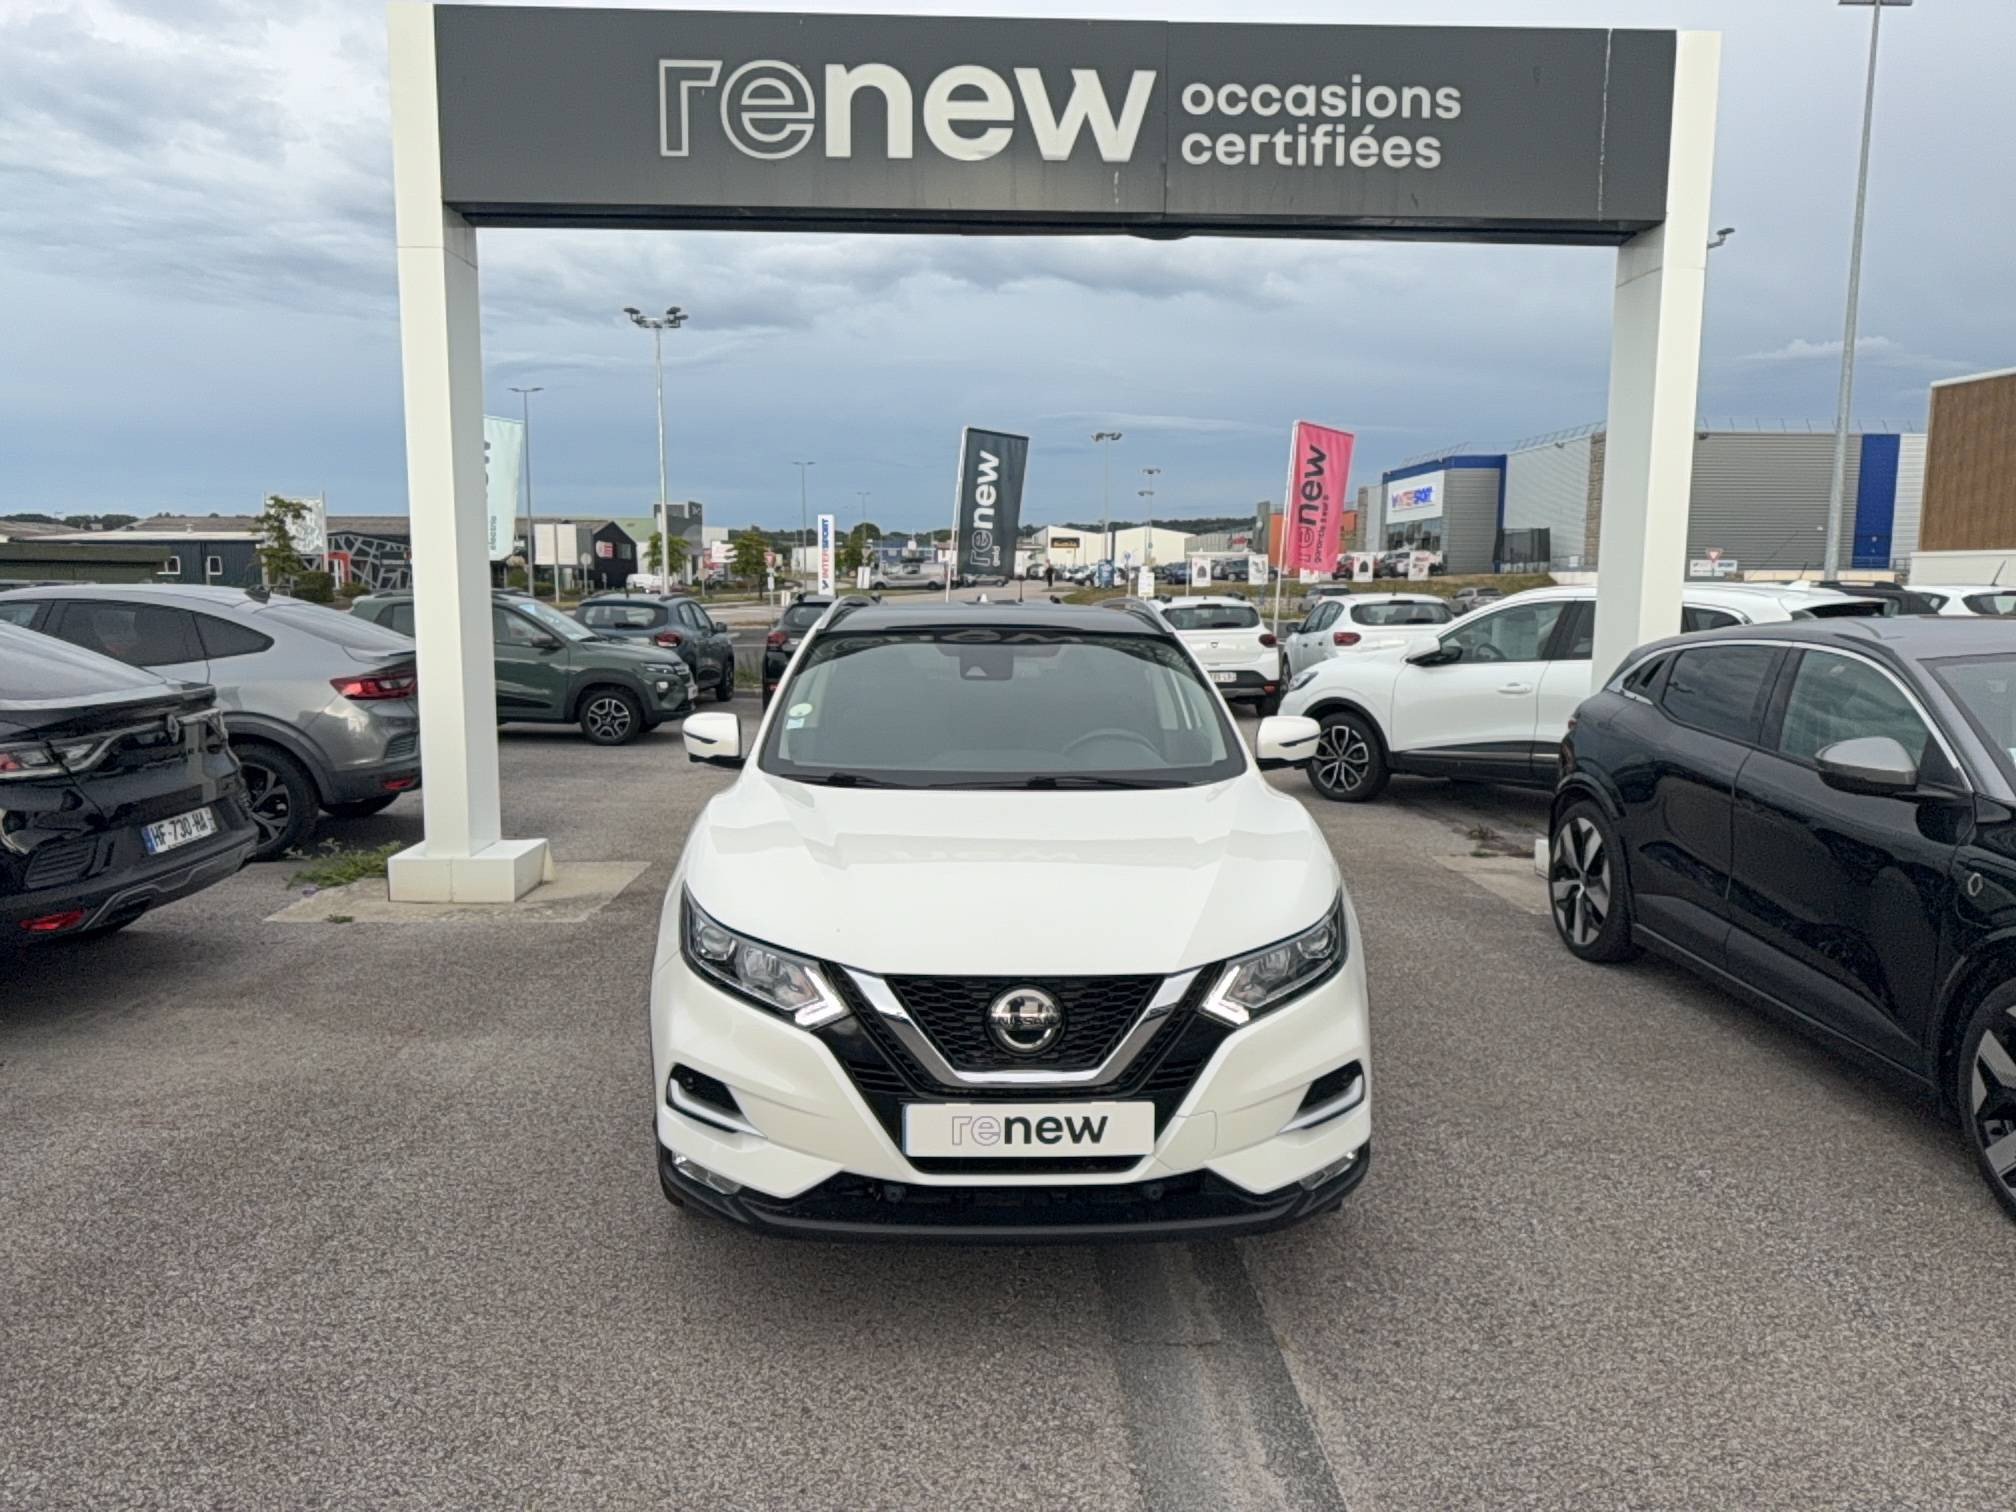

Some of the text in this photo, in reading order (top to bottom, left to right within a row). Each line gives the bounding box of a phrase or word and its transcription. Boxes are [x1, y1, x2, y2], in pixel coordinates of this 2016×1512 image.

[659, 59, 1157, 163] renew
[1181, 74, 1462, 119] occasions
[1181, 124, 1442, 169] certifiées
[970, 449, 1000, 567] renew
[1299, 443, 1327, 563] renew
[992, 1013, 1057, 1026] NISSAN
[951, 1116, 1109, 1146] renew
